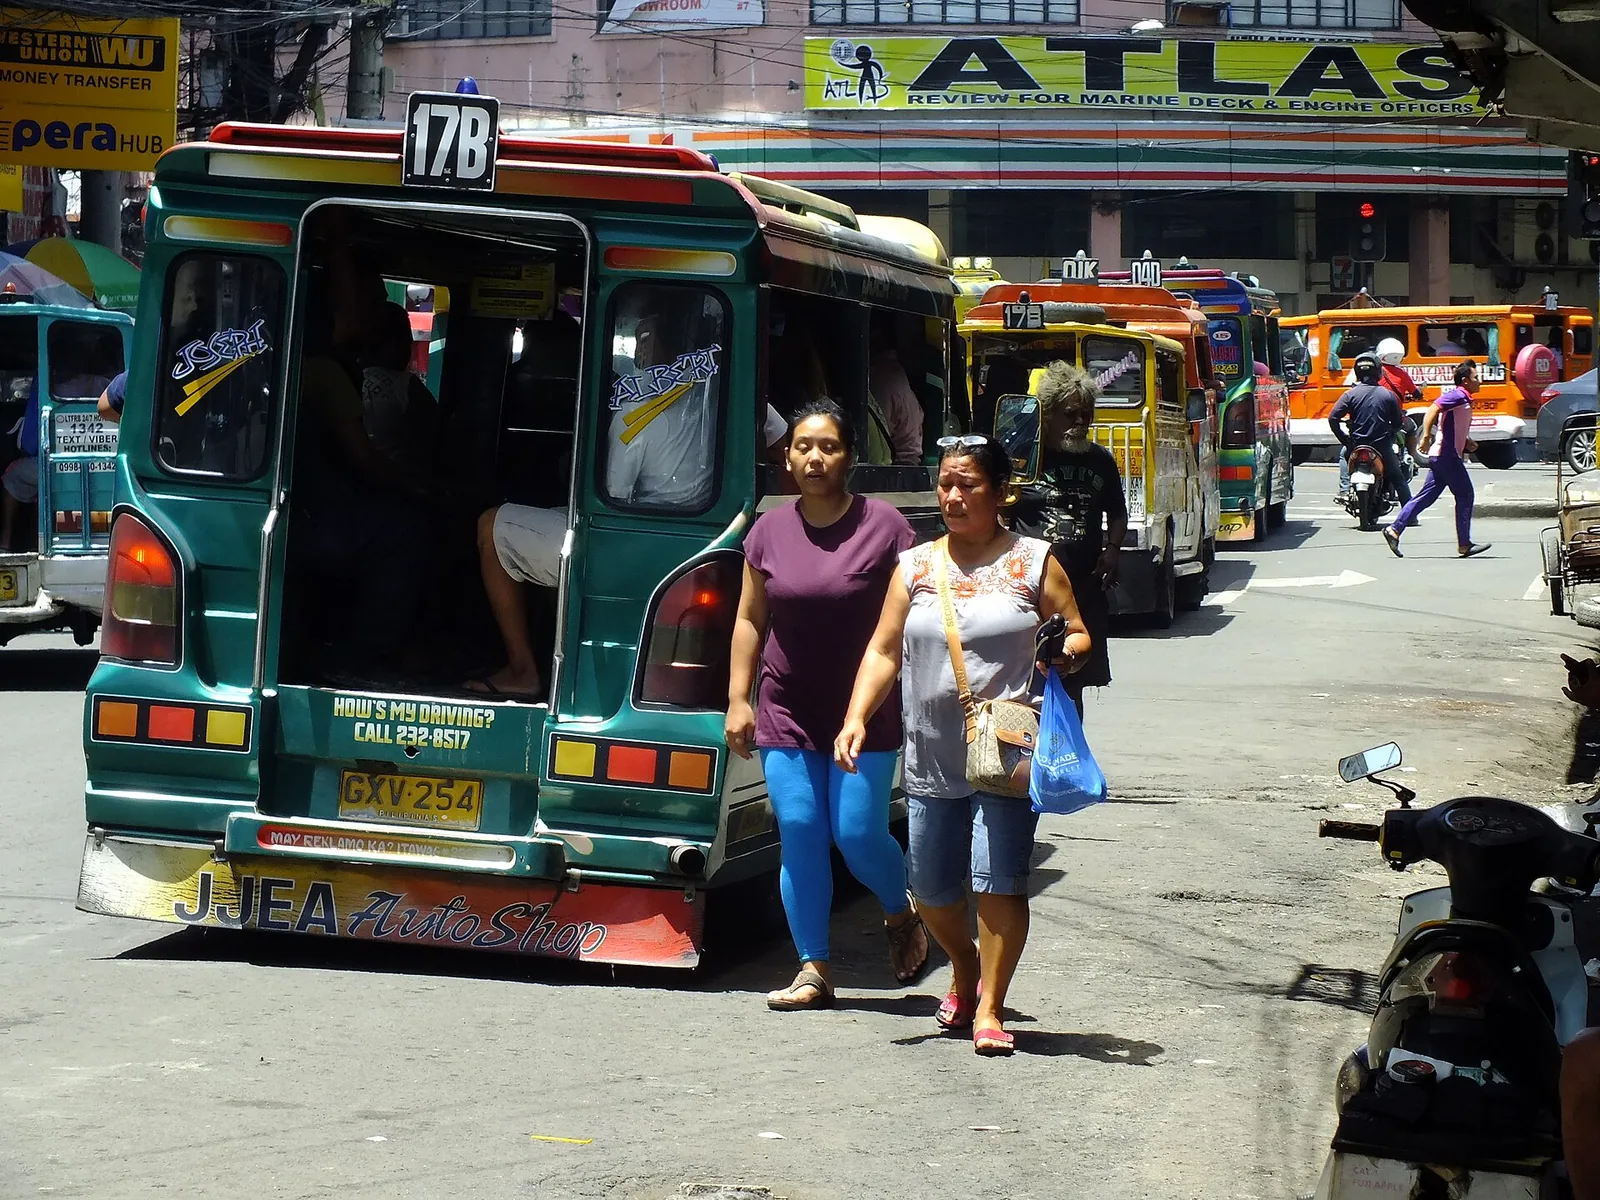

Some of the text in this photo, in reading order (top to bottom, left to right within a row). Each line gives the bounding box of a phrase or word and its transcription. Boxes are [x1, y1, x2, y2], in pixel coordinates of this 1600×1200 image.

[20, 47, 87, 63] UNION
[99, 37, 154, 66] WU
[0, 69, 152, 90] MONEY TRANSFER
[907, 37, 1474, 100] ATLAS
[907, 93, 1474, 113] REVIEW FOR MARINE DECK & ENGINE OFFICERS
[12, 119, 163, 153] pera HUB
[413, 102, 491, 179] 17B
[1005, 304, 1043, 329] 17B
[172, 318, 269, 380] JOSEPH
[608, 343, 722, 411] ALBERT
[57, 435, 81, 444] TEXT
[89, 434, 118, 444] VIBER
[70, 422, 104, 434] 1342
[63, 445, 112, 453] HOTLINES:
[333, 697, 495, 729] HOW'S MY DRIVING?
[354, 722, 393, 744] CALL
[379, 810, 438, 822] PILIPINAS
[270, 831, 302, 846] MAY
[303, 834, 365, 852] REKLAMO
[367, 838, 394, 856] KA?
[173, 871, 608, 957] JJEA Auto Shop
